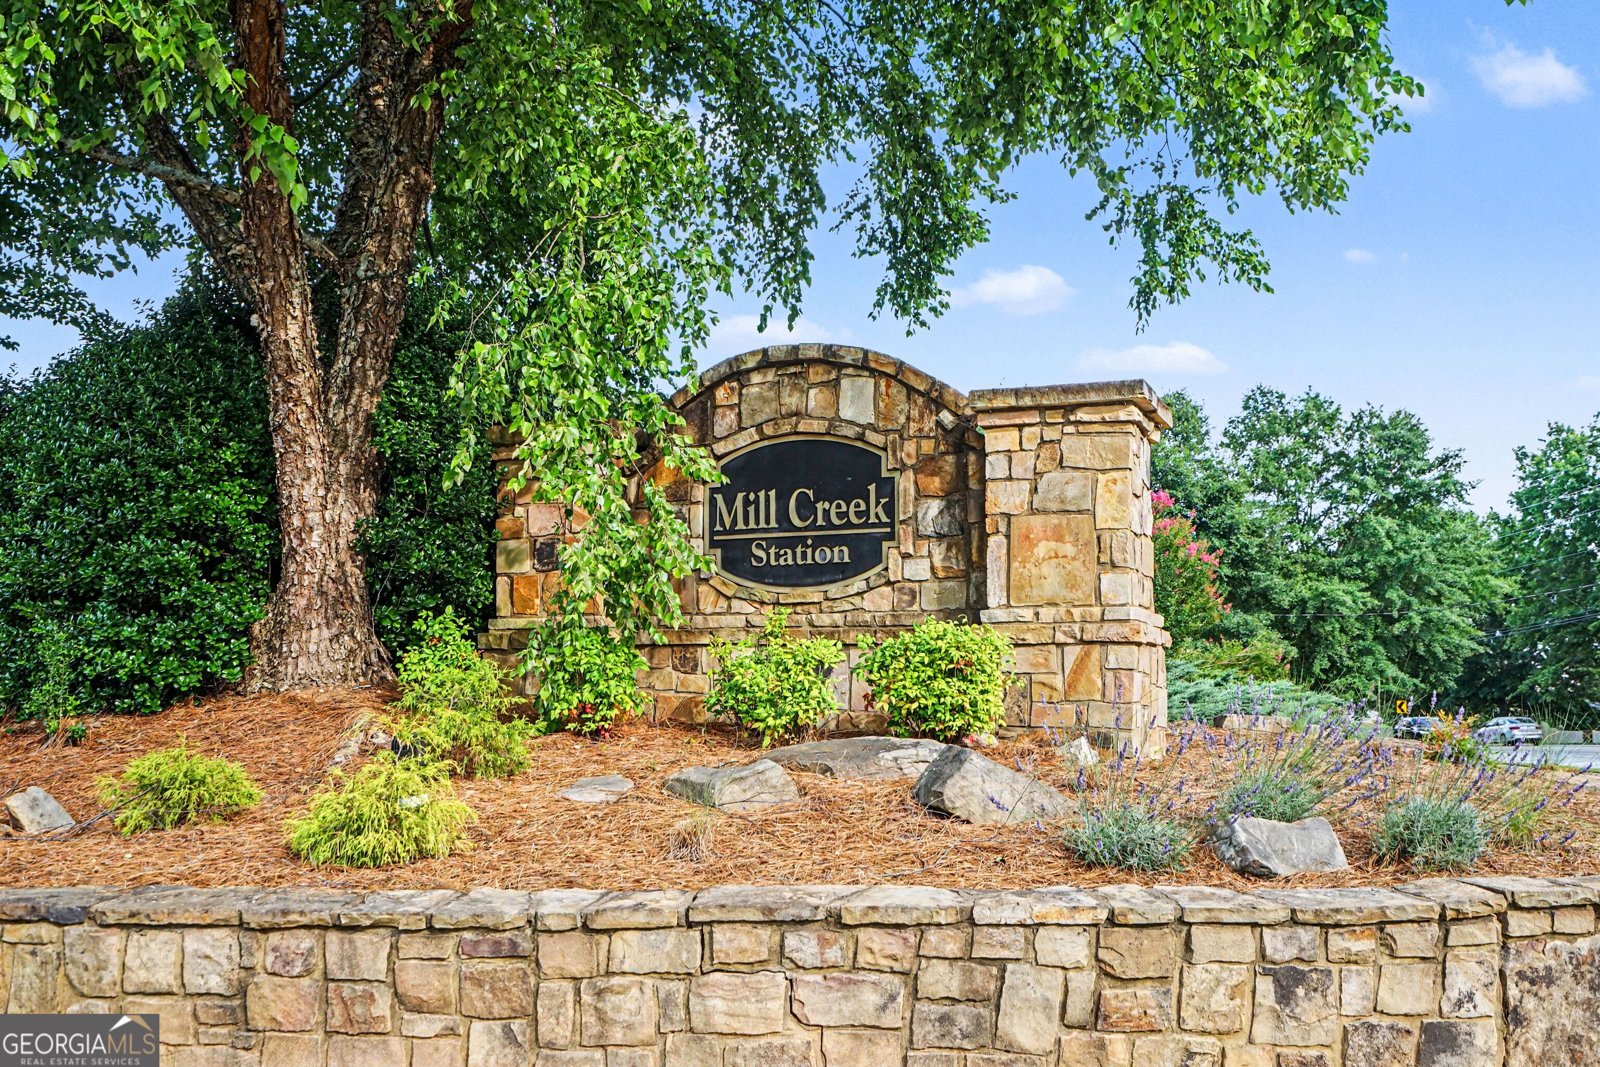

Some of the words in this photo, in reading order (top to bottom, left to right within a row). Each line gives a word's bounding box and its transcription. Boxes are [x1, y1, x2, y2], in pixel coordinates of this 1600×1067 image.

[714, 488, 779, 531] Mill
[788, 483, 891, 528] Creek
[751, 538, 851, 567] Station
